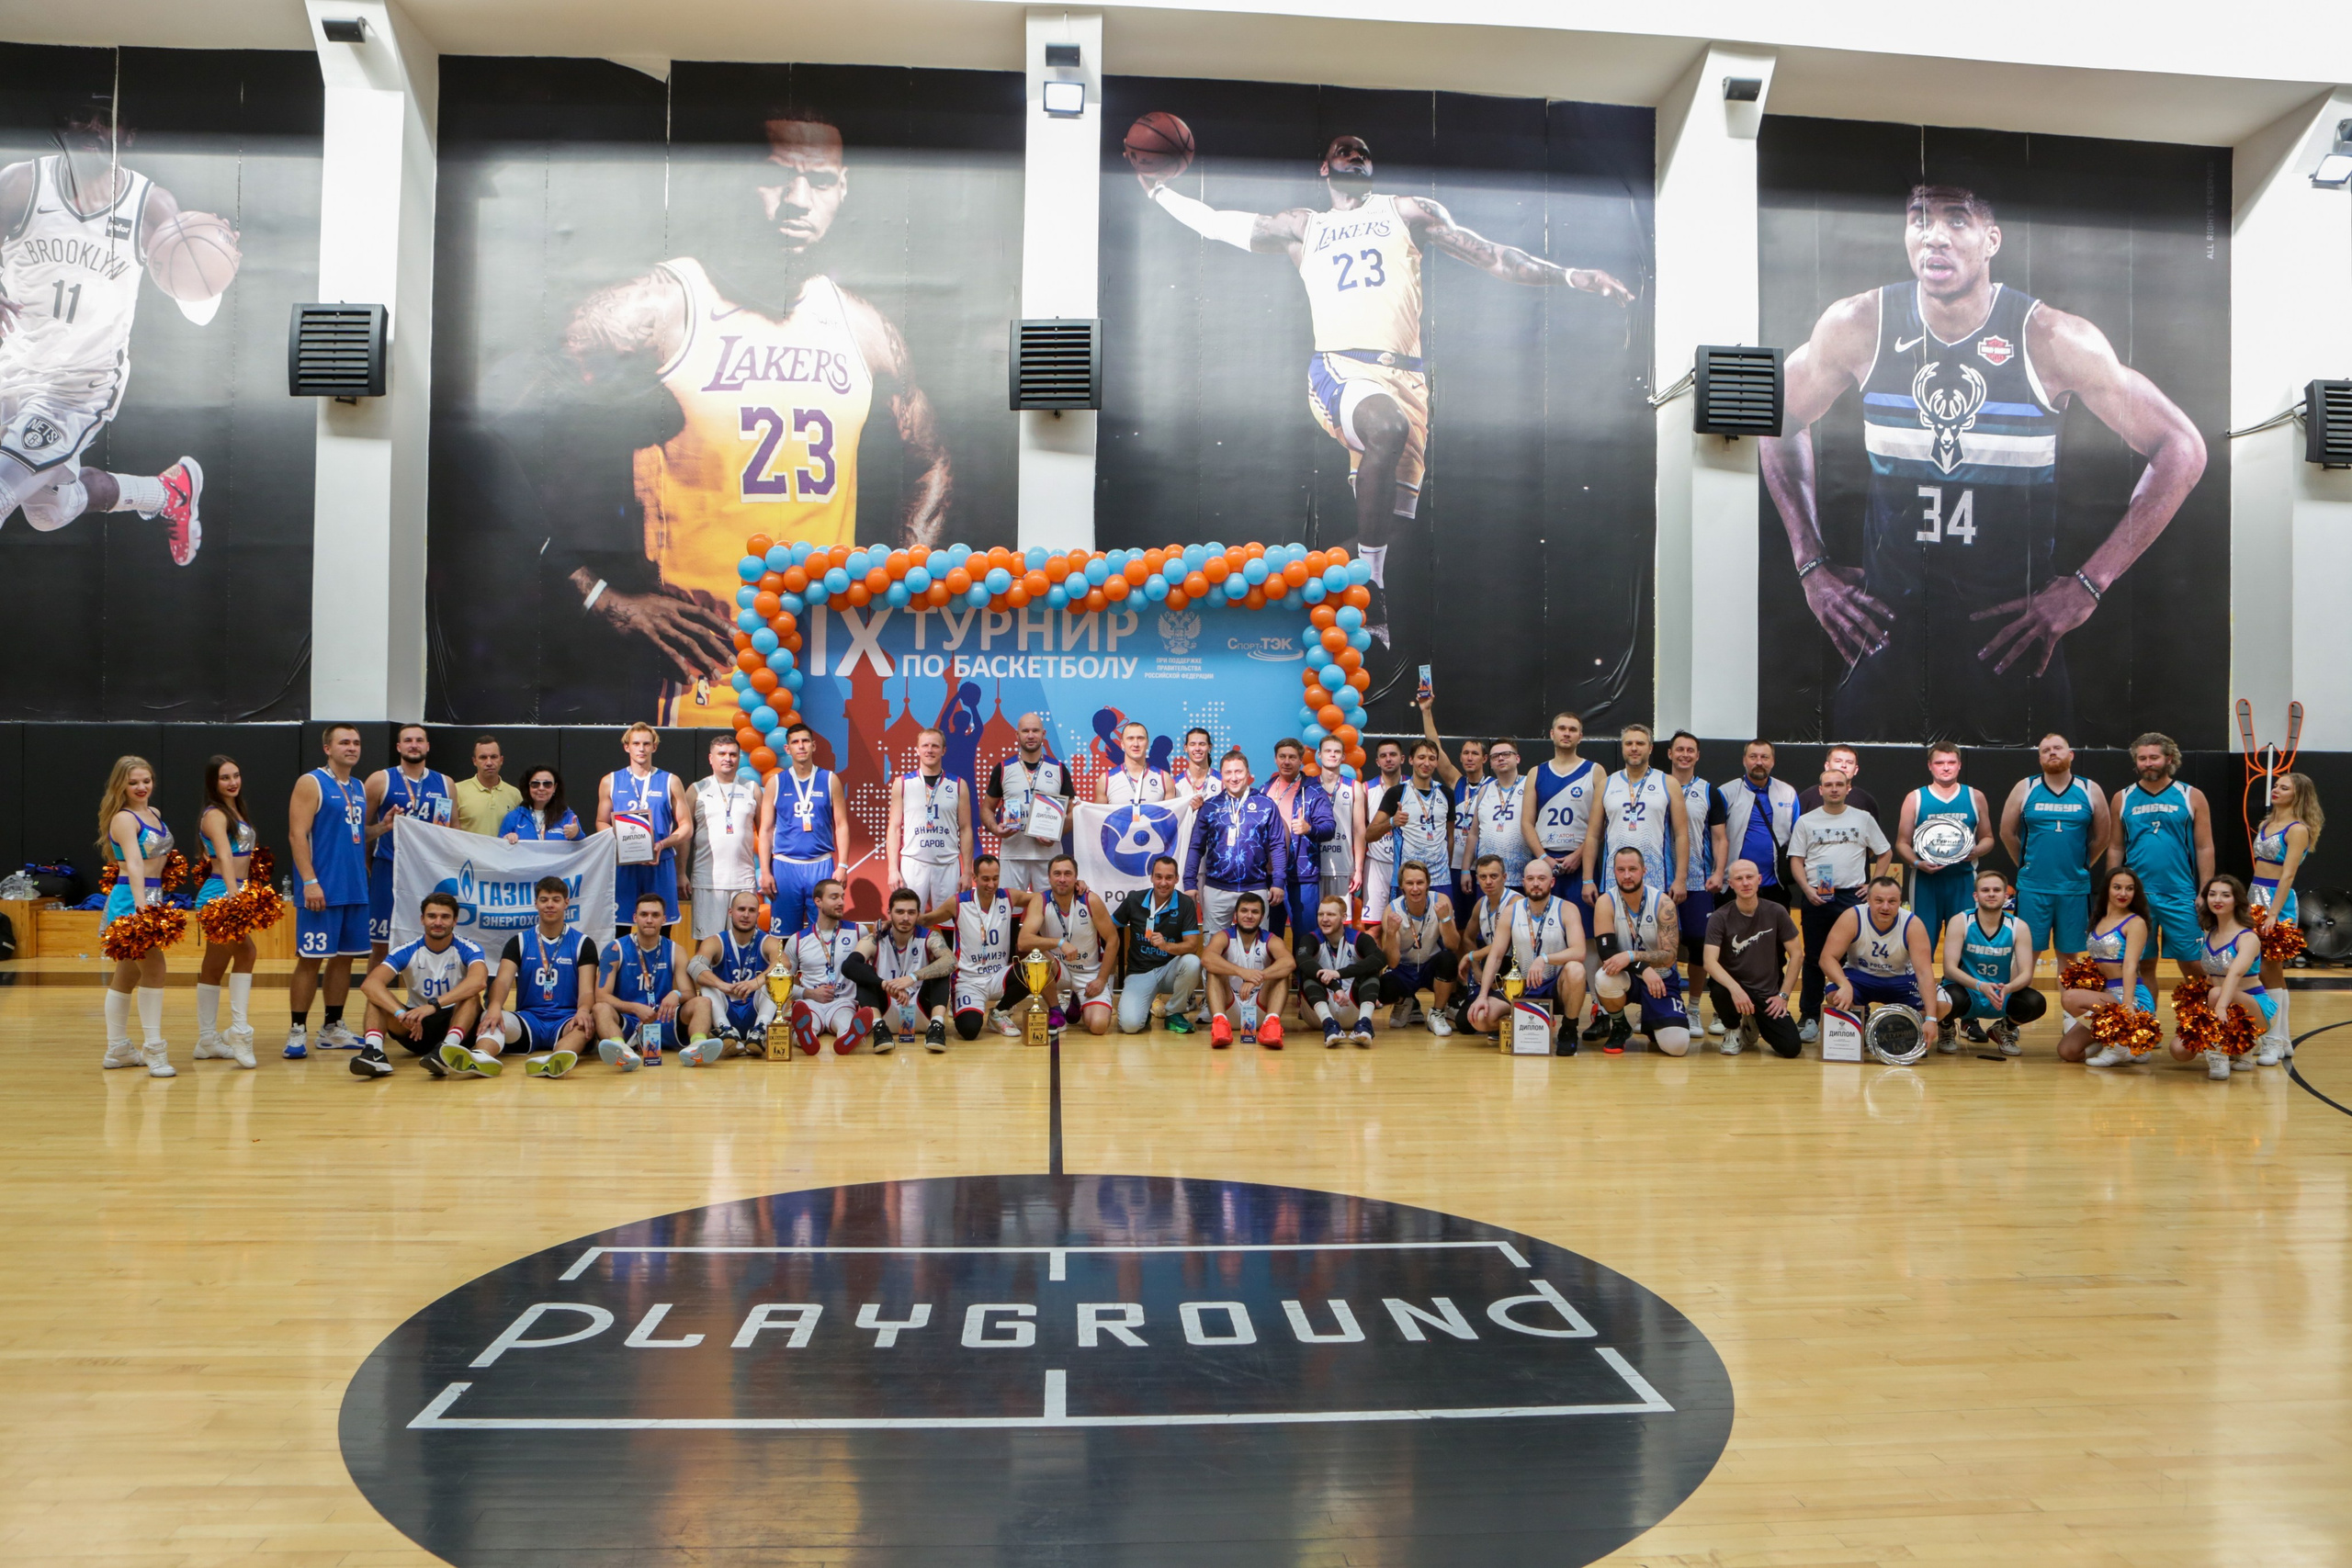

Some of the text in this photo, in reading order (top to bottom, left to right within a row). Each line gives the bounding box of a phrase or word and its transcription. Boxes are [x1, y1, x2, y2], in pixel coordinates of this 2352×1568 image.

[1314, 220, 1391, 254] LAKERS
[25, 238, 130, 280] BROOKLYN
[1332, 249, 1385, 292] 23
[52, 279, 82, 324] 11
[701, 335, 852, 394] LAKERS
[28, 419, 59, 444] NETS
[740, 406, 837, 501] 23
[1917, 486, 1978, 544] 34
[810, 604, 1138, 677] IX ТУРНИР
[902, 655, 1138, 679] ПО БАСКЕТБОЛУ
[345, 806, 362, 825] 33
[1035, 812, 1057, 820] ДИПЛОМ
[1547, 807, 1574, 826] 20
[2034, 802, 2082, 812] СИБУР
[2132, 803, 2179, 816] СИБУР
[2054, 819, 2063, 832] 1
[2152, 820, 2161, 834] 7
[479, 874, 582, 906] ГАЗПМ
[1105, 890, 1136, 903] РО
[369, 919, 389, 937] 24
[303, 931, 327, 952] 33
[1140, 945, 1168, 957] САРОВ
[1871, 942, 1889, 958] 24
[1966, 943, 2012, 956] СИБУР
[535, 967, 559, 987] 69
[978, 964, 1002, 975] САРОВ
[1977, 963, 1998, 976] 33
[424, 977, 450, 997] 911
[956, 995, 971, 1009] 10
